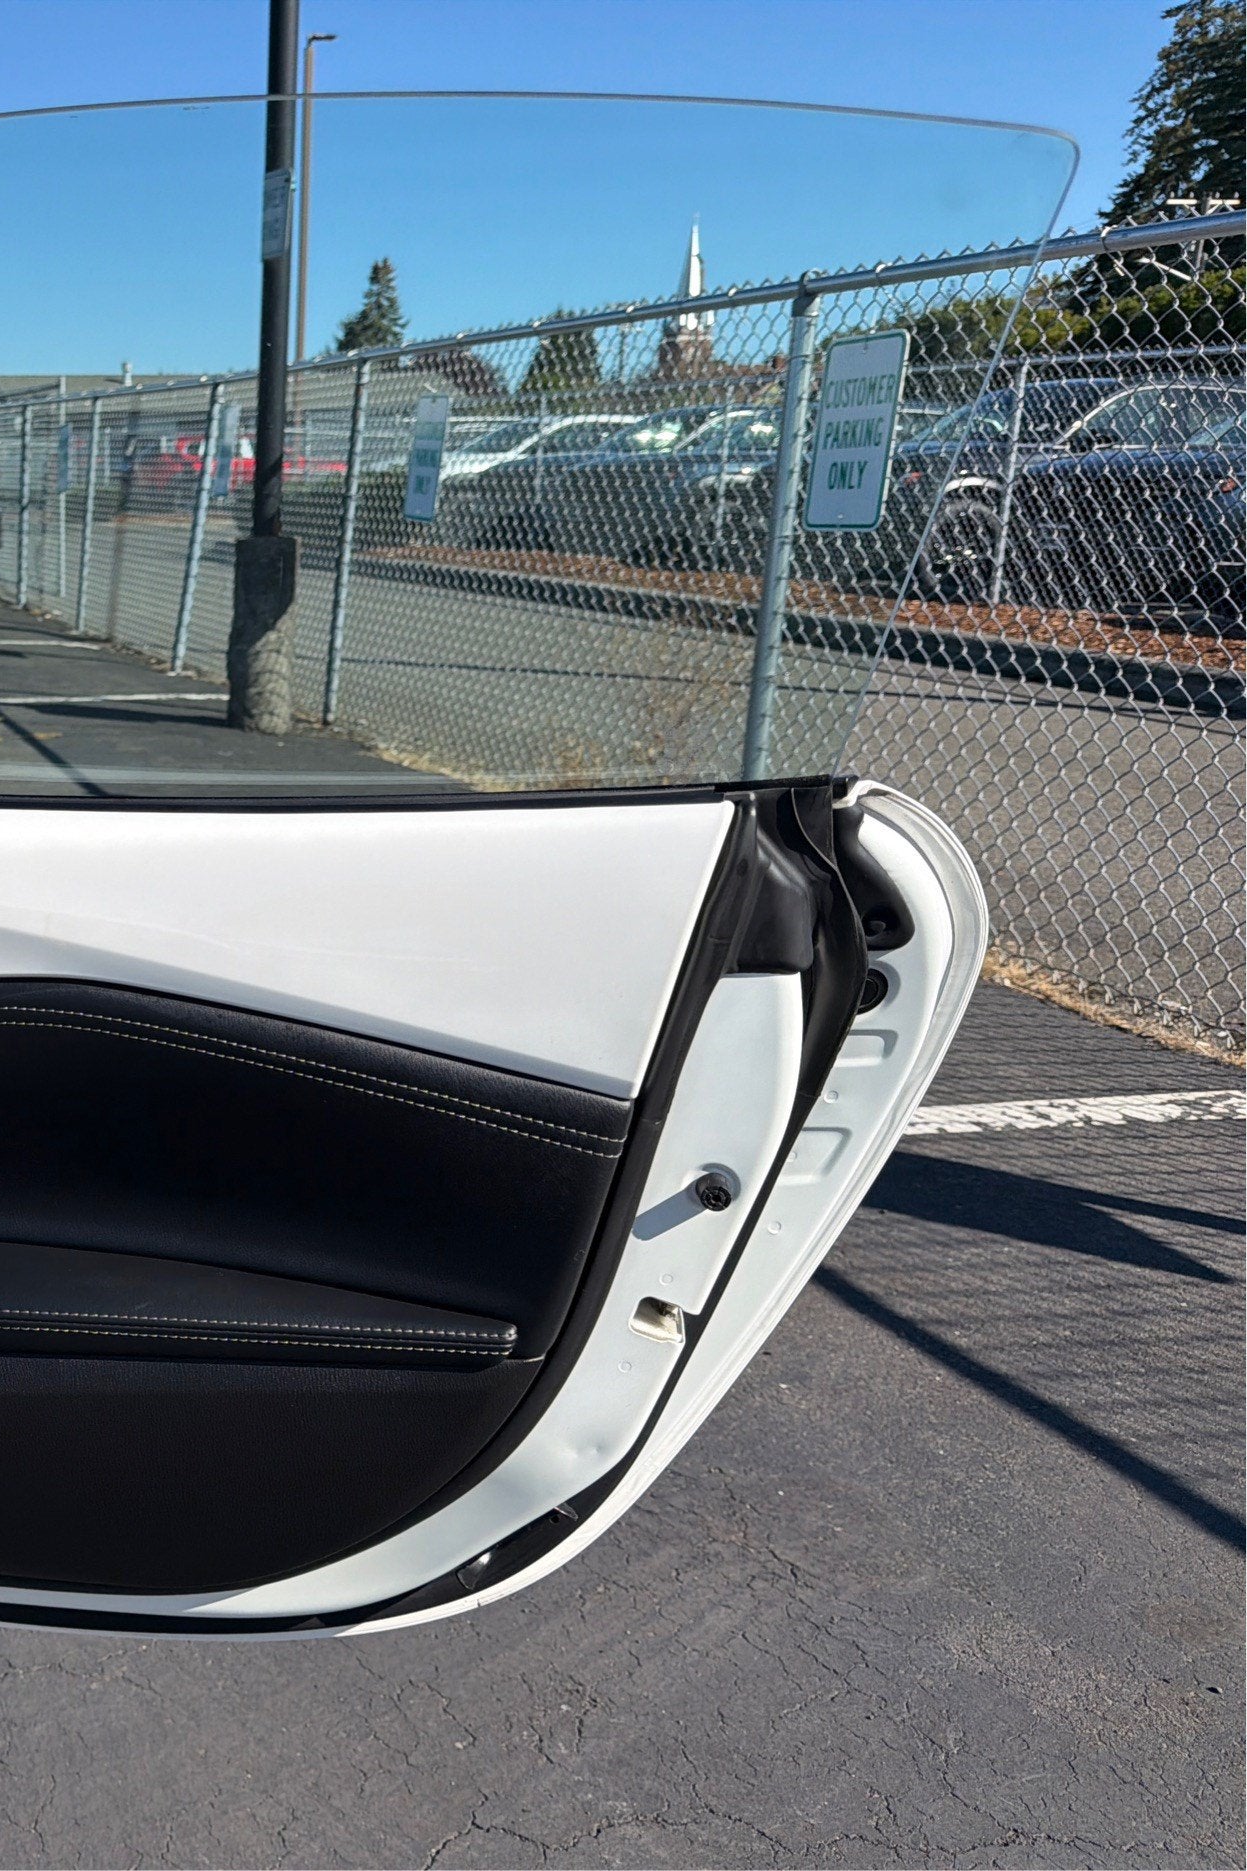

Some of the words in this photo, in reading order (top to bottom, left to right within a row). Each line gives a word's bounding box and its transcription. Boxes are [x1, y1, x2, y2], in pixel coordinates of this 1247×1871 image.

[825, 374, 896, 409] CUSTOMER
[824, 417, 884, 448] PARKING
[827, 460, 868, 490] ONLY
